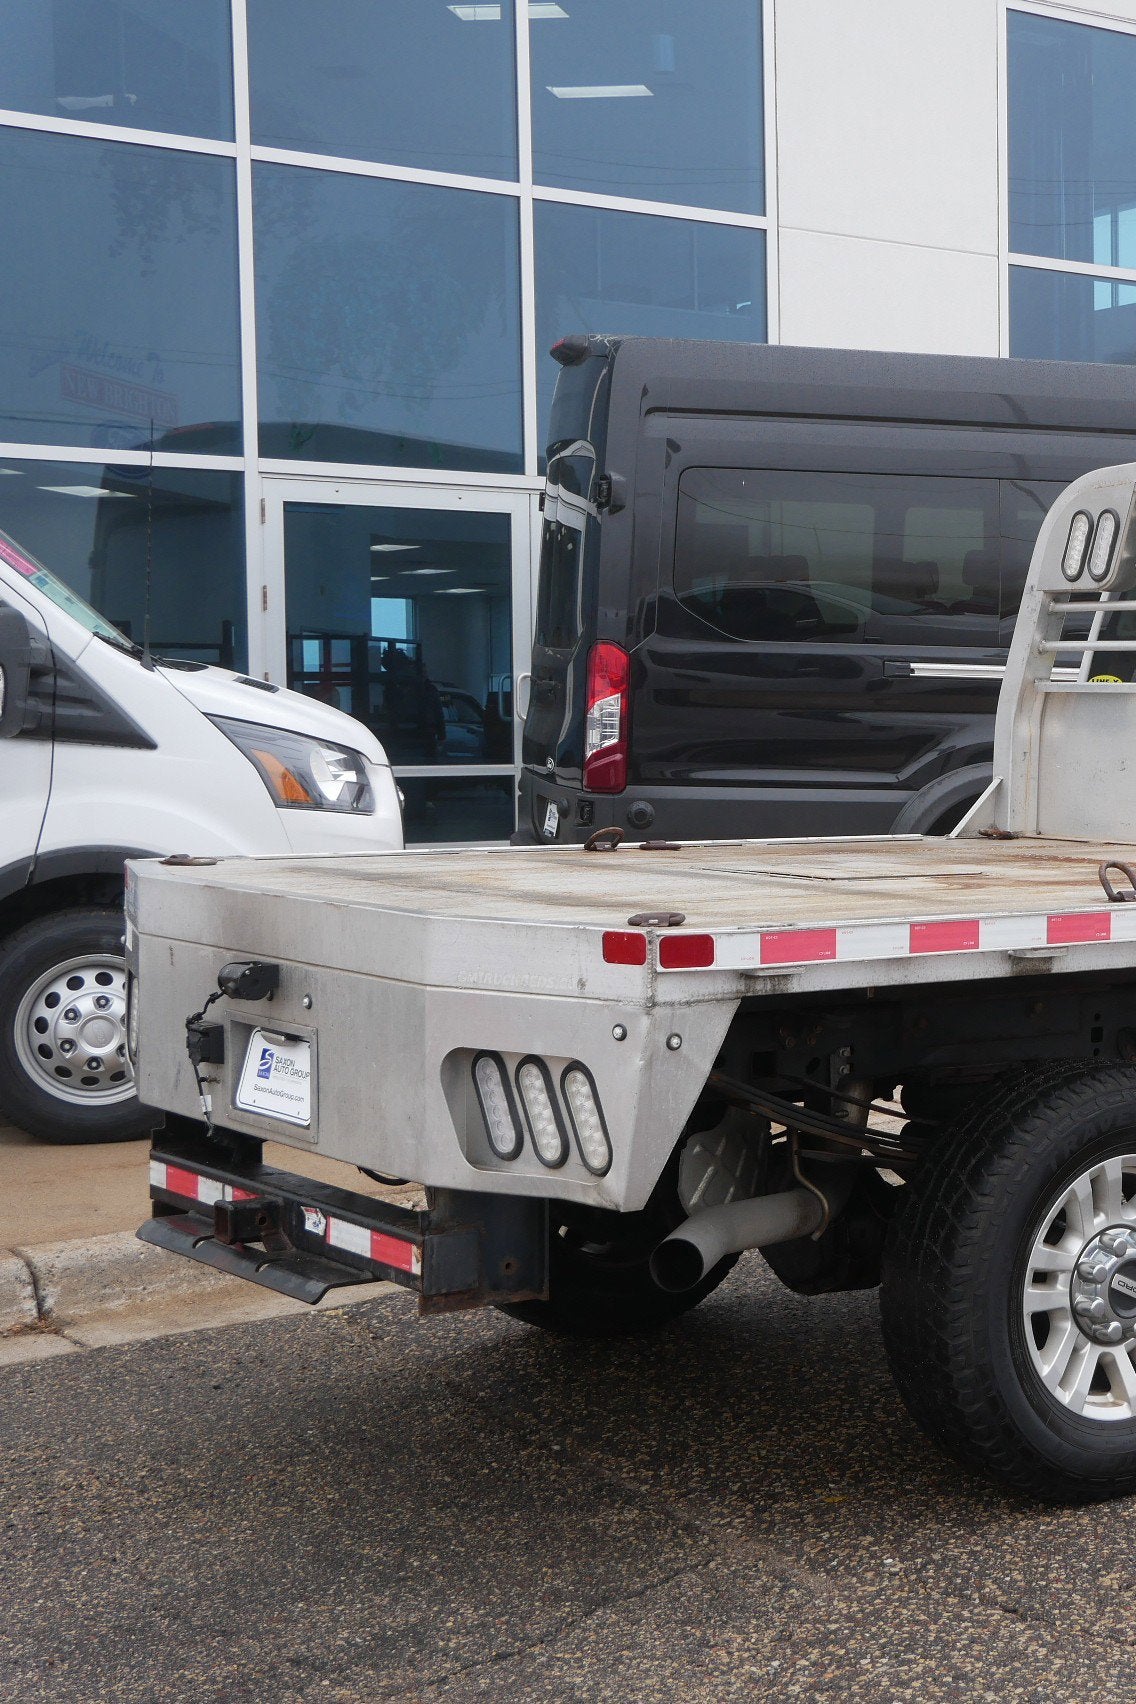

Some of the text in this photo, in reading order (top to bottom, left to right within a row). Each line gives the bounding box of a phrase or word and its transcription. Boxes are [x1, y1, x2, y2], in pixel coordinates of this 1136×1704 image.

[275, 1056, 296, 1068] SAXON
[273, 1065, 290, 1075] AUTO
[290, 1067, 310, 1080] GROUP
[253, 1083, 305, 1103] SaxonAutoGroup.com
